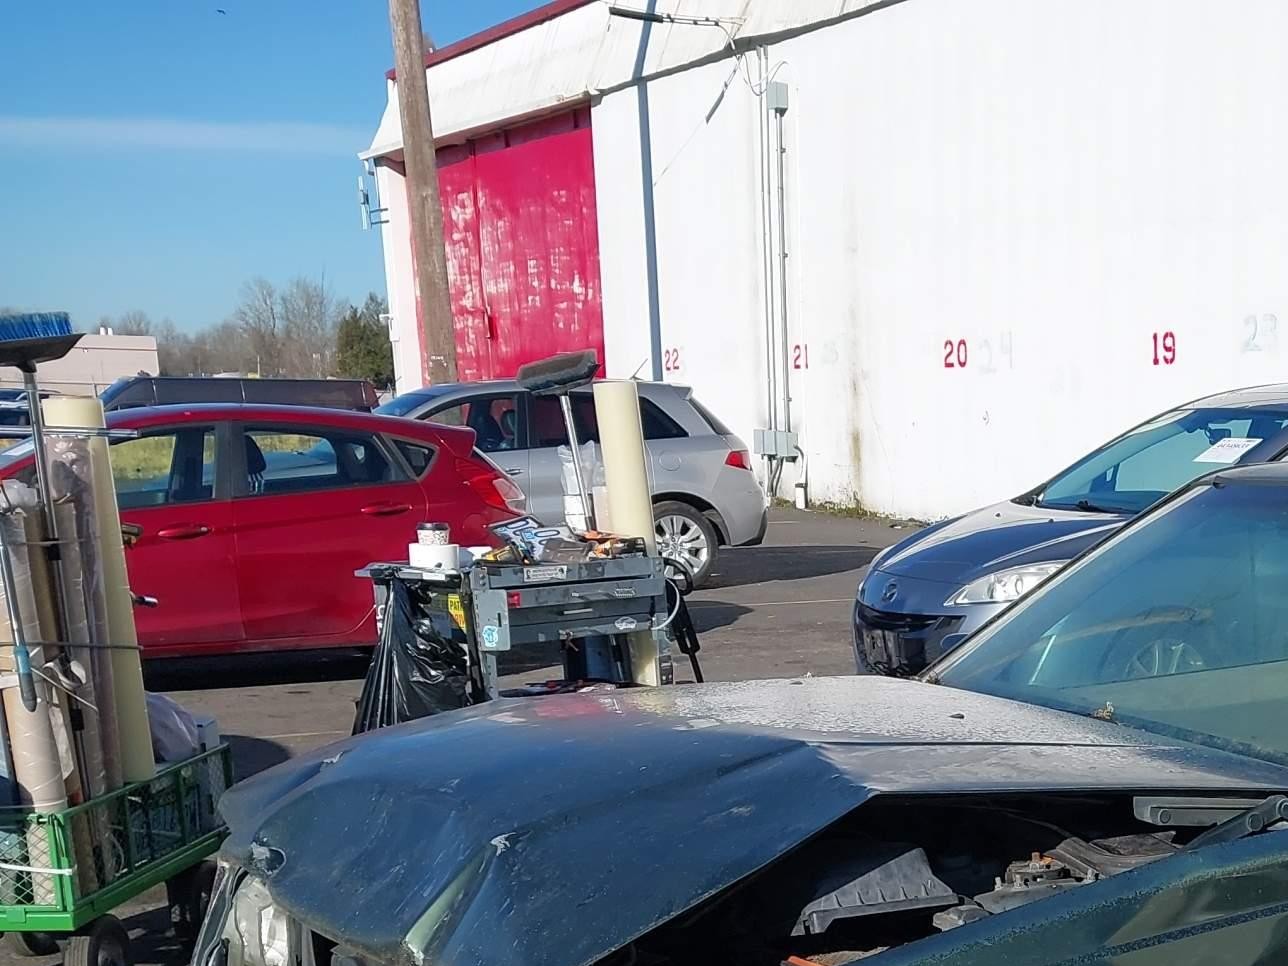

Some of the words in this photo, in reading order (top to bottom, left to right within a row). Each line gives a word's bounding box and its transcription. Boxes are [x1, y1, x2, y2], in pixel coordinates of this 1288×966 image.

[664, 348, 681, 372] 22
[792, 344, 809, 370] 21
[943, 338, 968, 369] 20
[1152, 331, 1177, 366] 19
